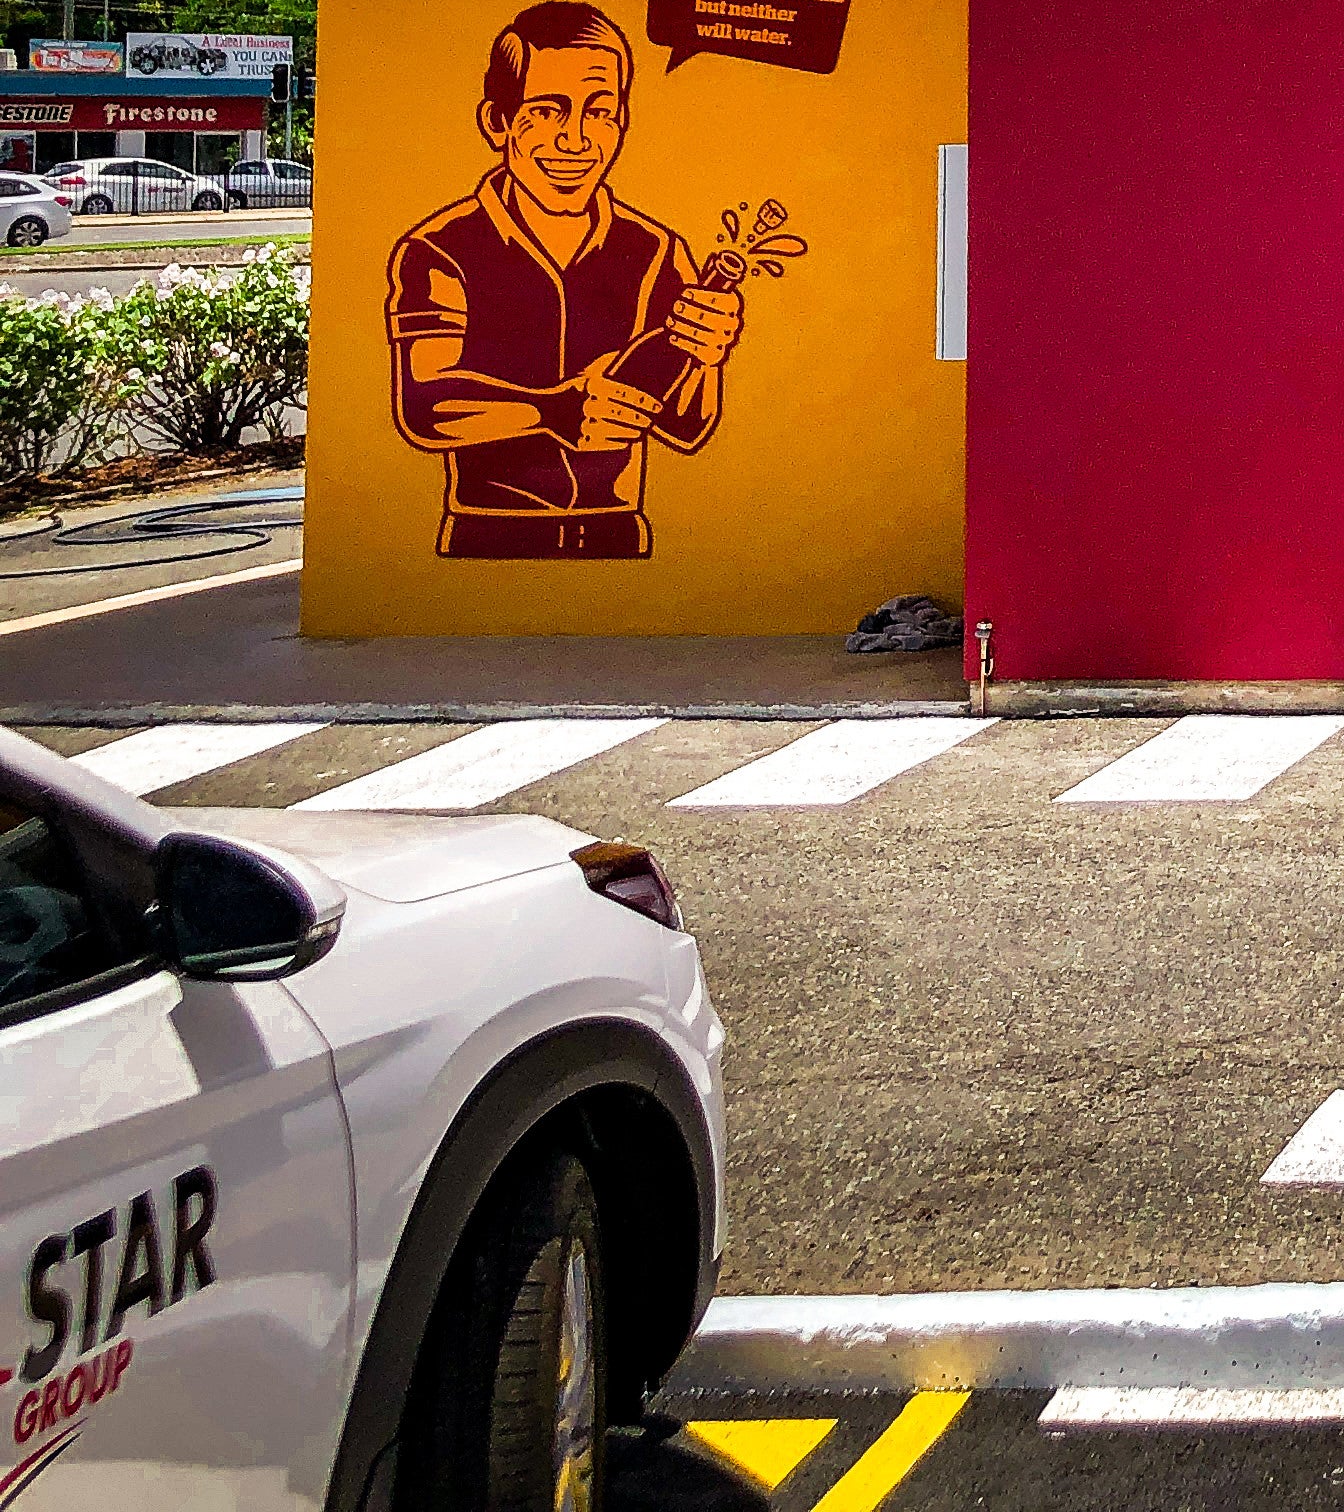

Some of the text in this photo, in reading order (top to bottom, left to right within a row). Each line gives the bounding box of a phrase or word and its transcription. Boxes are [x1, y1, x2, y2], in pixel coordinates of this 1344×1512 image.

[728, 2, 798, 22] neither
[201, 35, 210, 48] A
[246, 36, 290, 49] Business
[696, 22, 793, 45] will water.
[232, 50, 288, 63] YOU CAN
[0, 104, 73, 123] ESTONE
[103, 103, 218, 125] Firestone
[19, 1164, 219, 1384] STAR
[14, 1339, 134, 1444] GROUP
